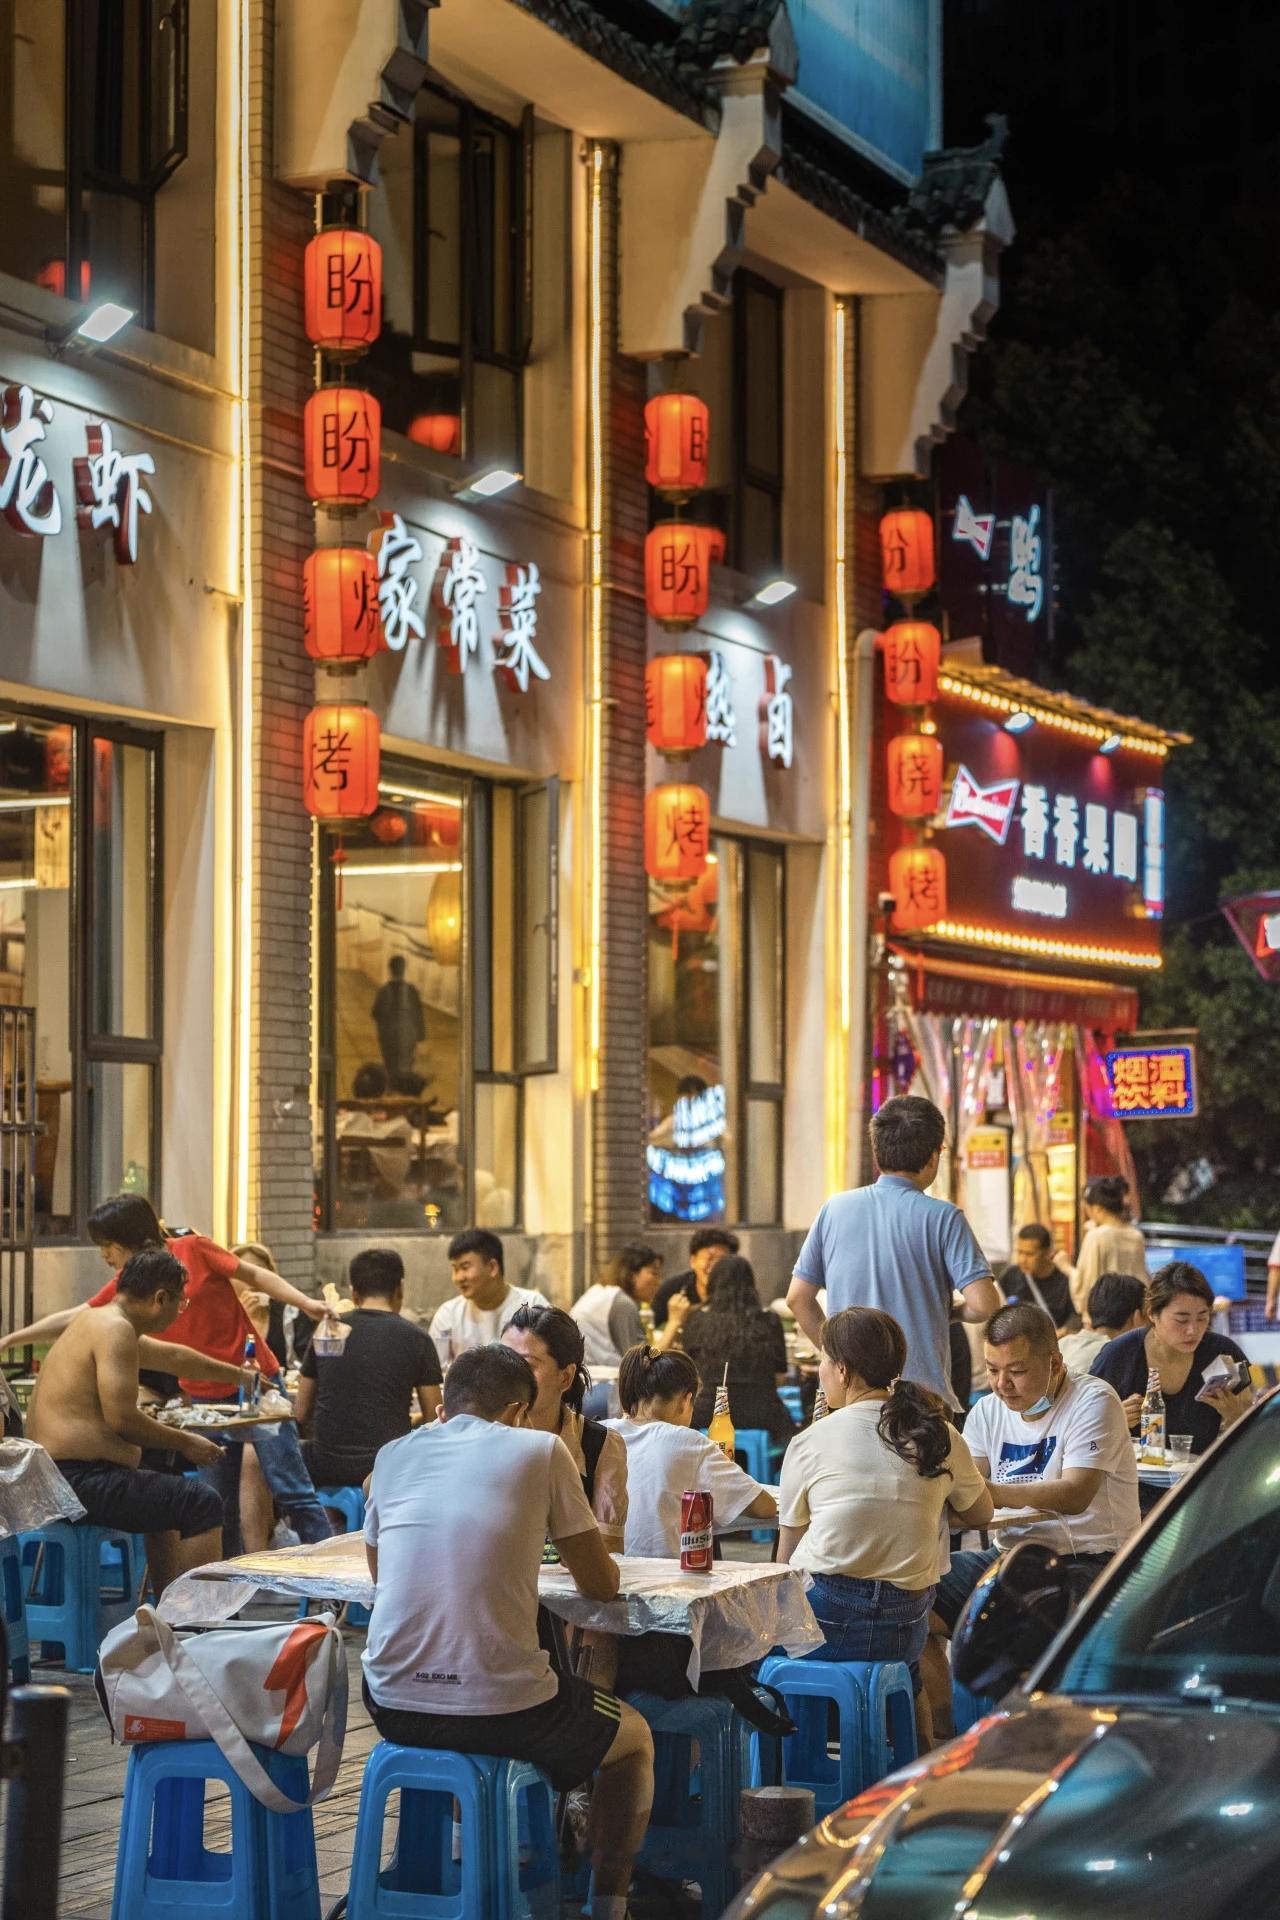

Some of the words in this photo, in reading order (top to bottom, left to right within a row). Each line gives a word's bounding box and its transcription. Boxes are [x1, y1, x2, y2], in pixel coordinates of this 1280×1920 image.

[327, 253, 374, 316] 盼
[322, 411, 373, 473] 盼
[376, 515, 552, 693] 家常菜
[1111, 1081, 1188, 1110] 饮料
[1112, 1054, 1186, 1083] 烟酒
